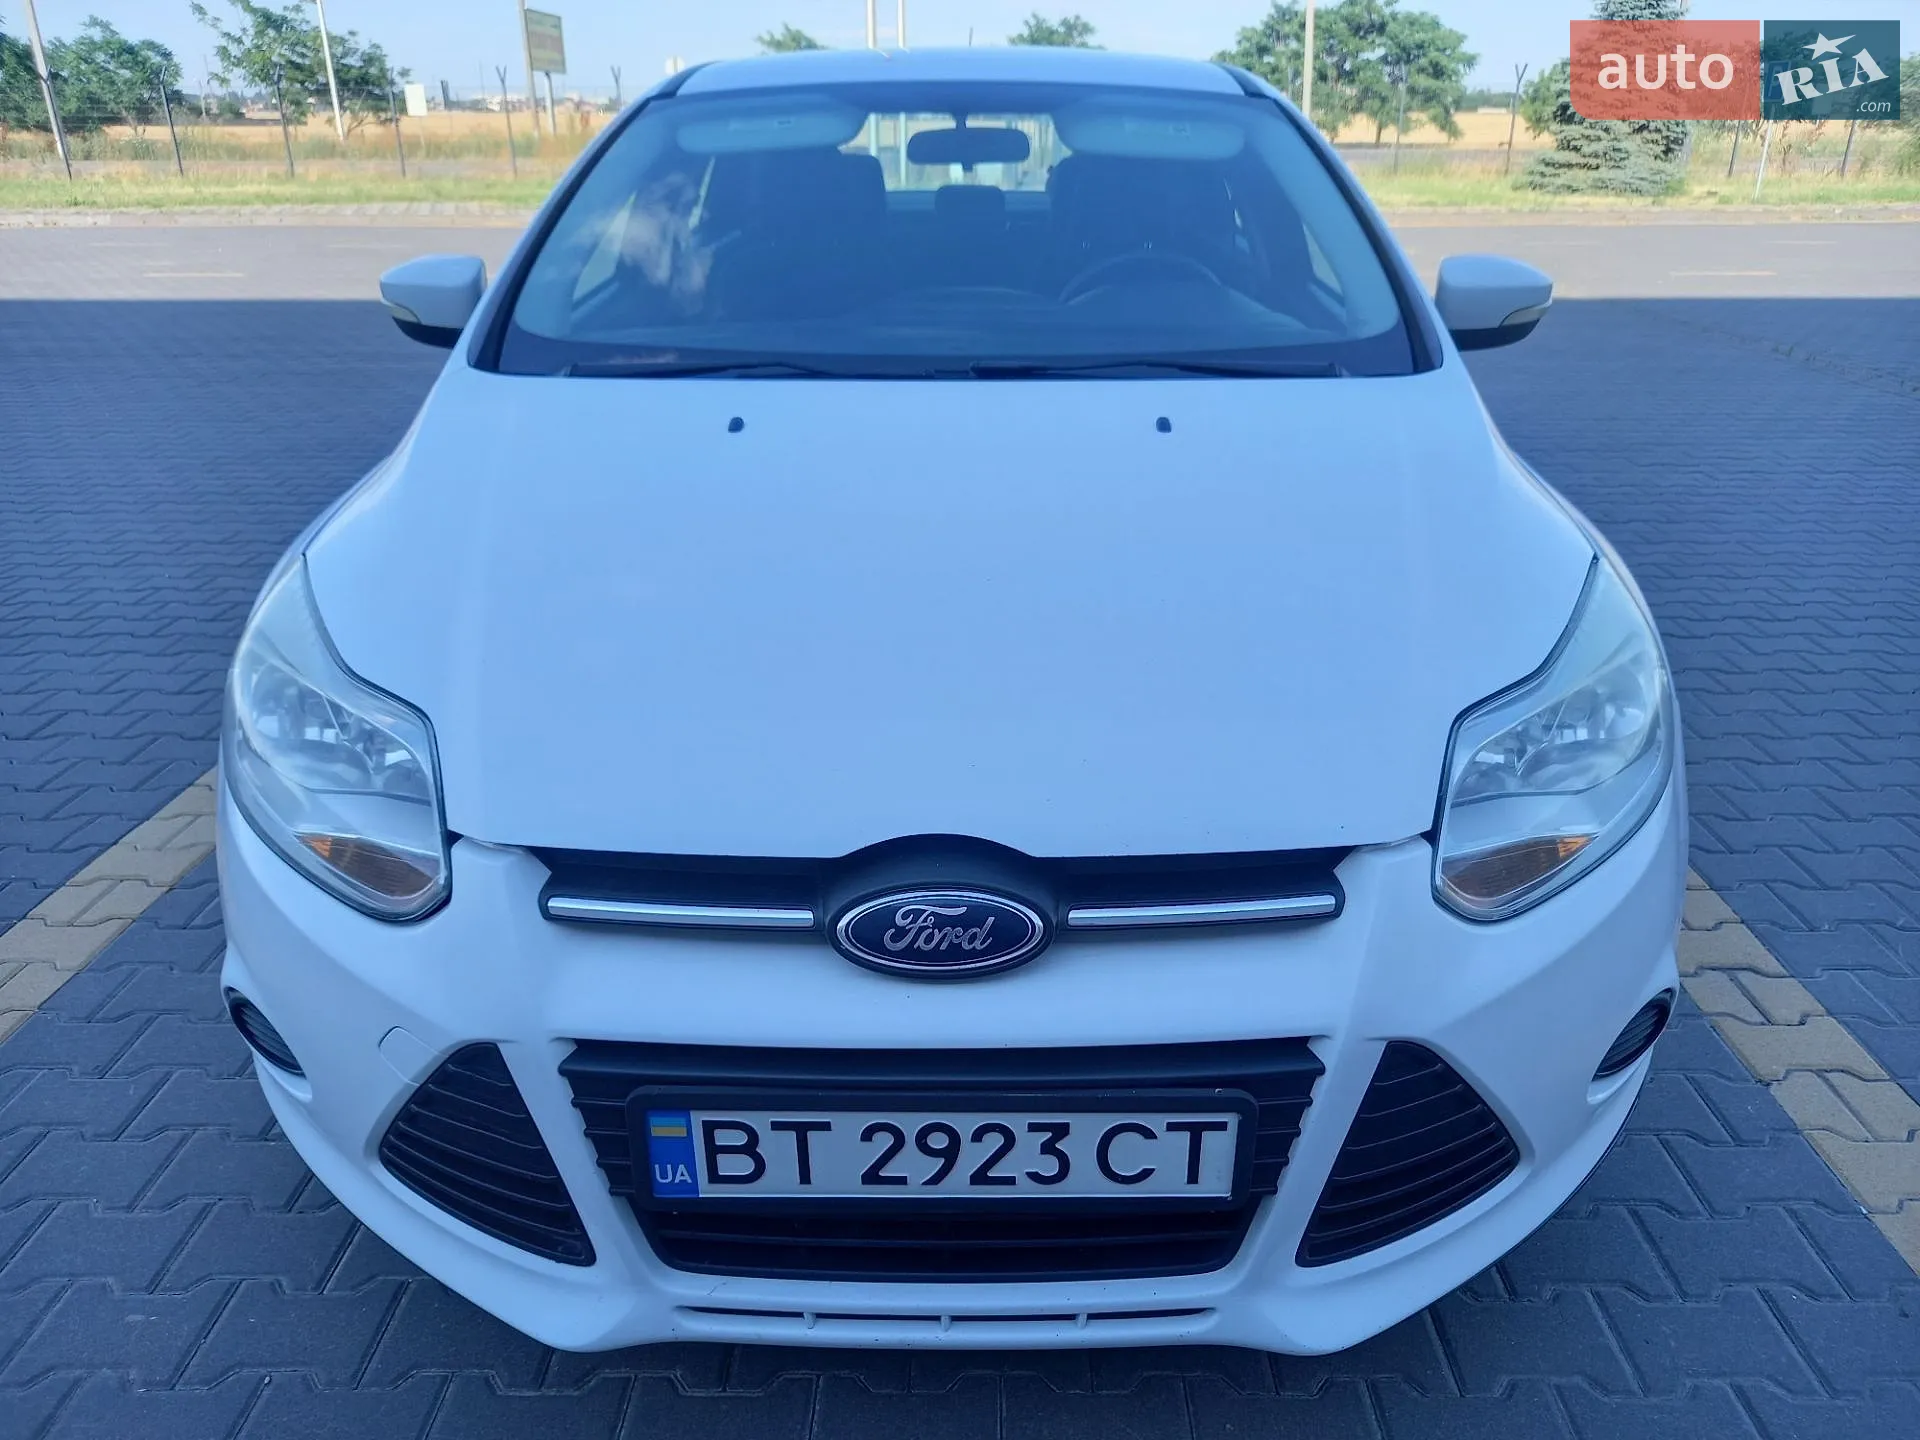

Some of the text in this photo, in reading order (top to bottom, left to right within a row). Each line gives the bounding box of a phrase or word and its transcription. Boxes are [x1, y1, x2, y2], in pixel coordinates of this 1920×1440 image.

[883, 904, 996, 951] Ford
[654, 1163, 693, 1184] UA
[701, 1119, 1229, 1187] BT 2923 CT
